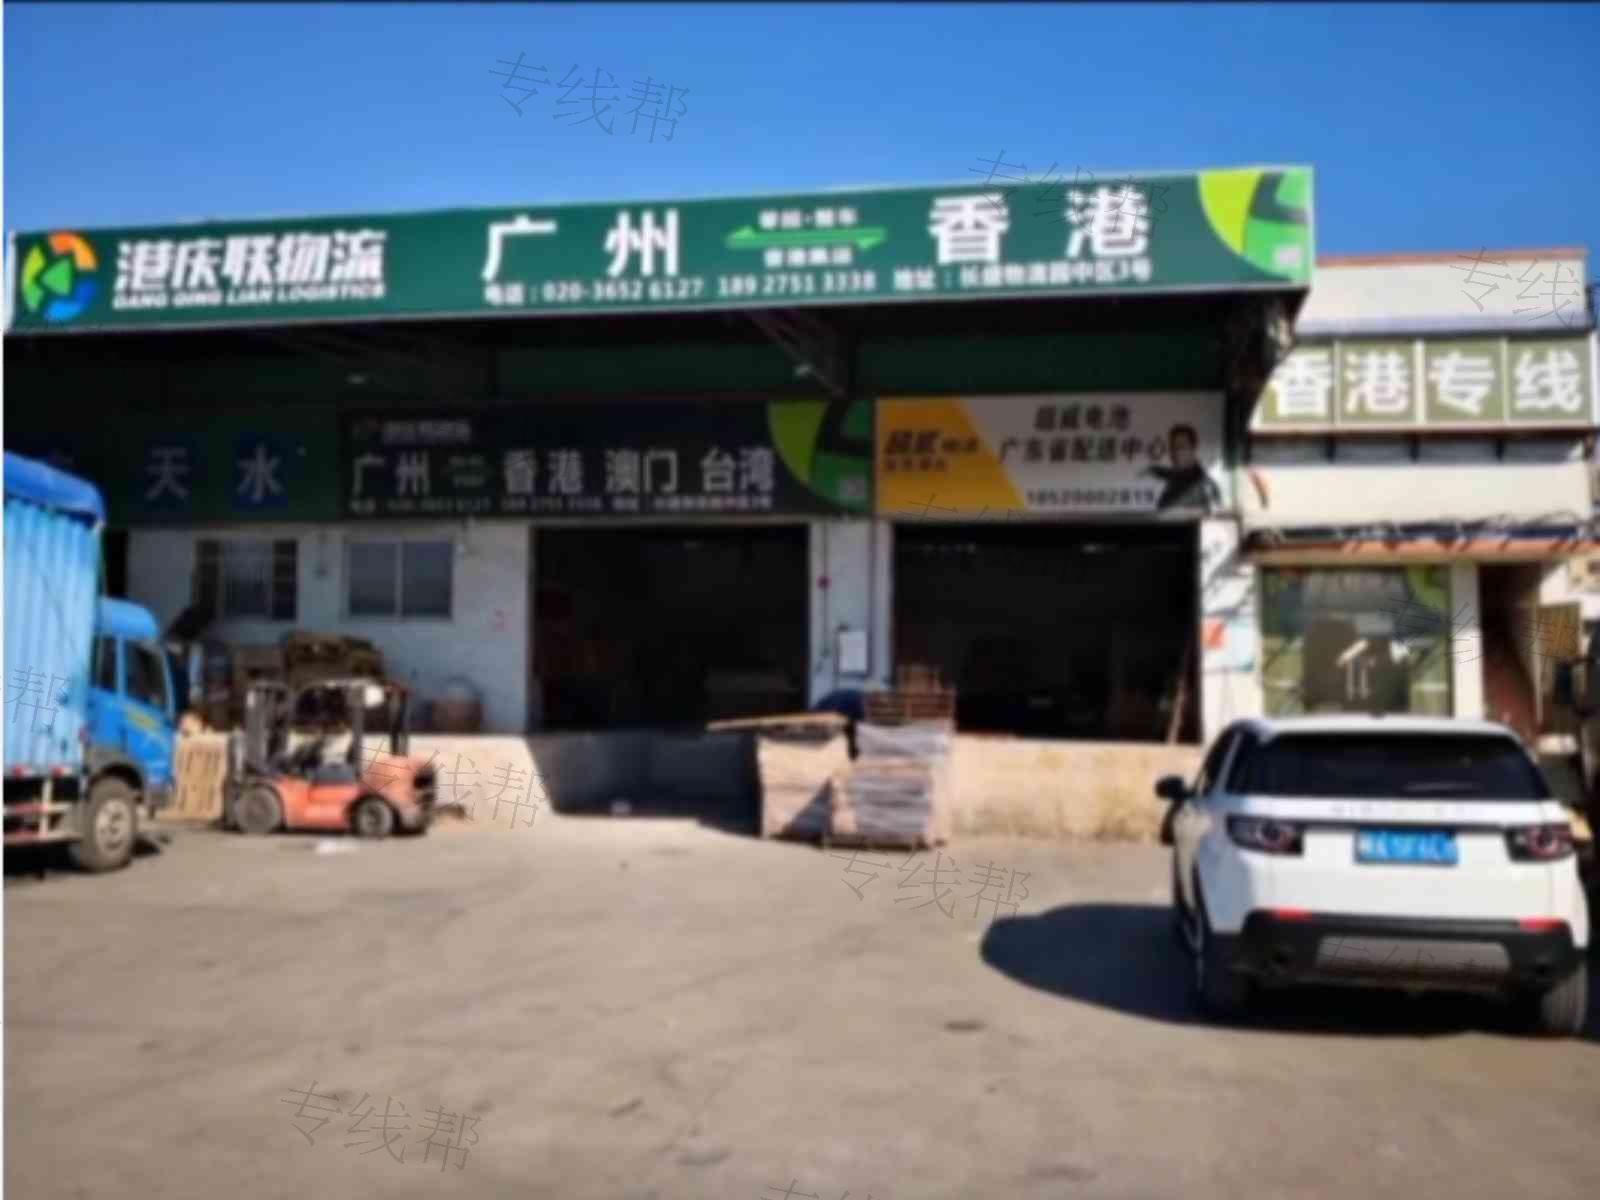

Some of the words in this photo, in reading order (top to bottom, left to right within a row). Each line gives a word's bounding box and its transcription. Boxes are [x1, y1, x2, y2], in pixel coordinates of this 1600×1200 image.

[114, 229, 386, 290] 港庆联物流
[482, 209, 679, 281] 广州
[1269, 348, 1583, 416] 香港专线
[350, 450, 431, 496] 广州
[502, 447, 584, 496] 香港
[605, 446, 679, 496] 澳门
[699, 445, 776, 496] 台湾
